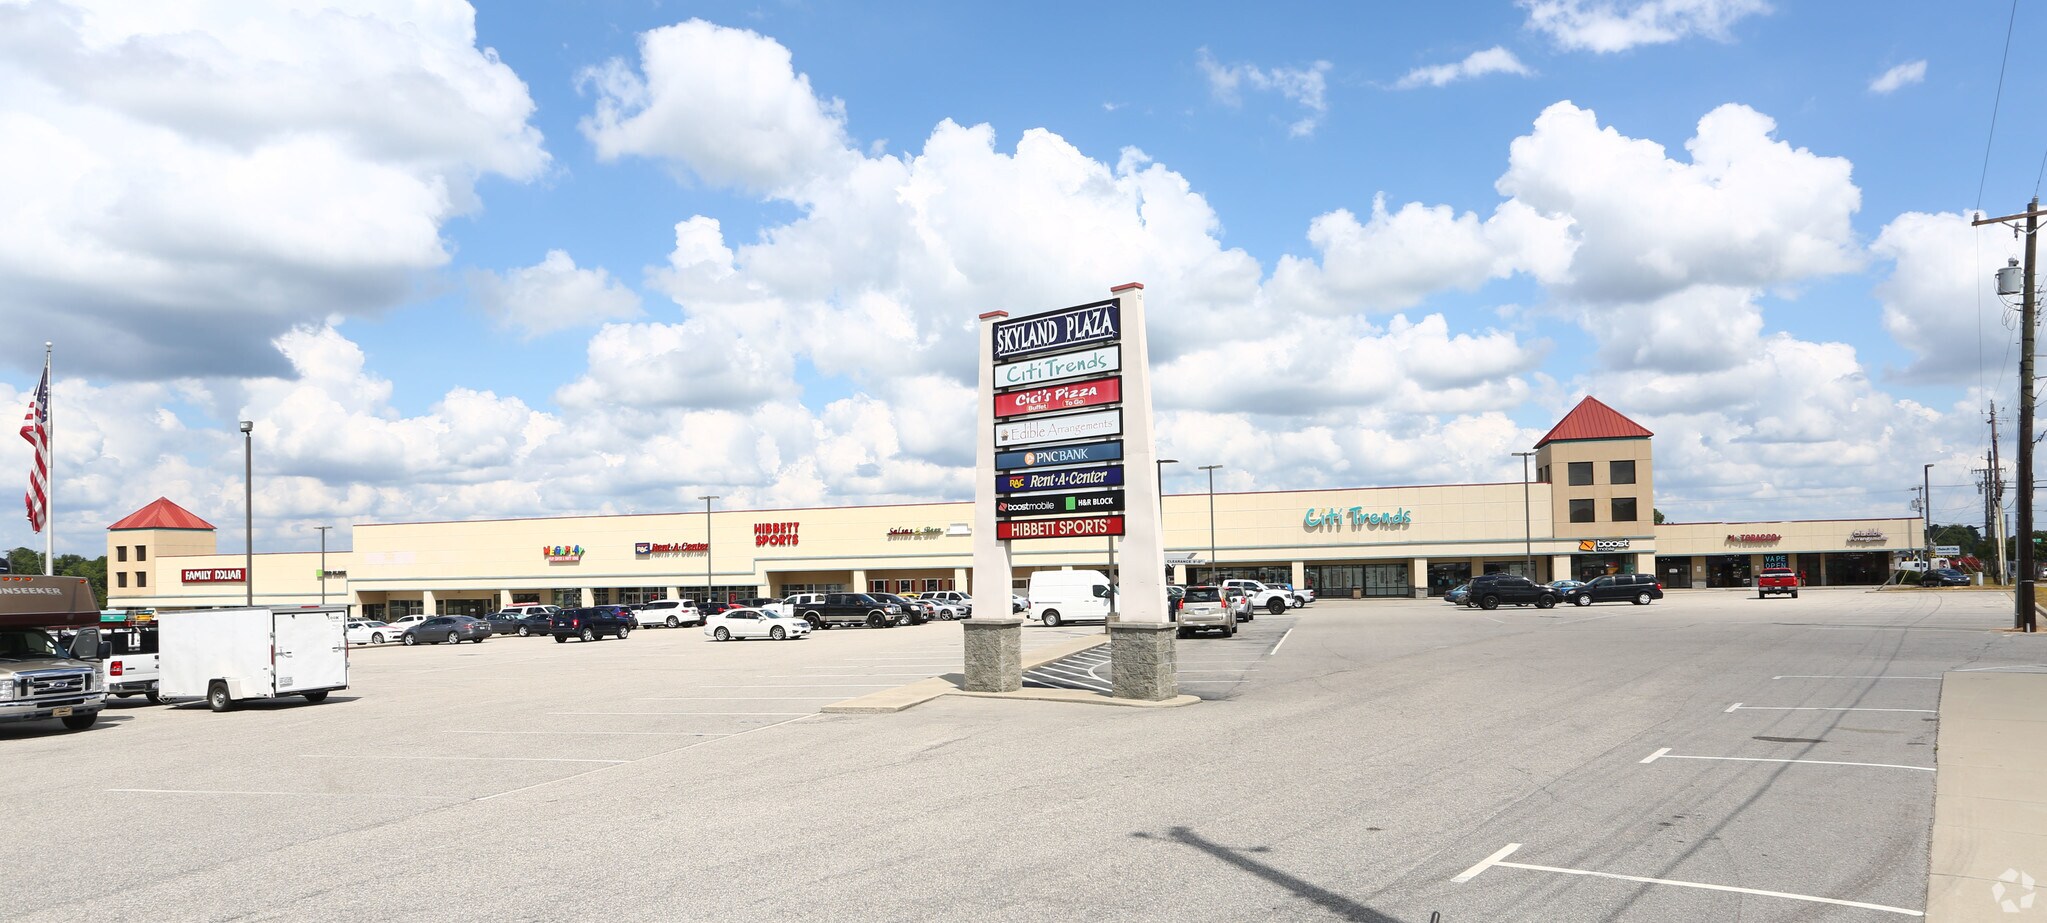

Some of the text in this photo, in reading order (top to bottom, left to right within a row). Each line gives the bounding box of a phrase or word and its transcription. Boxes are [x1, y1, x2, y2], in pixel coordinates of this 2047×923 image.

[997, 307, 1114, 352] SKYLAND PLAZA
[1007, 352, 1107, 382] Citi Trends
[1015, 386, 1098, 406] Cici's Pizza
[1028, 403, 1047, 411] Buffet
[1011, 420, 1113, 440] Edible Arrangements
[1036, 448, 1089, 463] PNC BANK
[1009, 478, 1025, 489] RAC
[1093, 497, 1114, 506] BLOCK
[1305, 505, 1412, 527] Citi Trends
[754, 522, 800, 534] HIBBETT
[1011, 522, 1056, 537] HIBBETT
[755, 534, 799, 546] SPORTS
[1597, 539, 1629, 548] boost
[543, 545, 585, 556] MEGAPLAY
[185, 569, 242, 580] FAMILY DOLLAR
